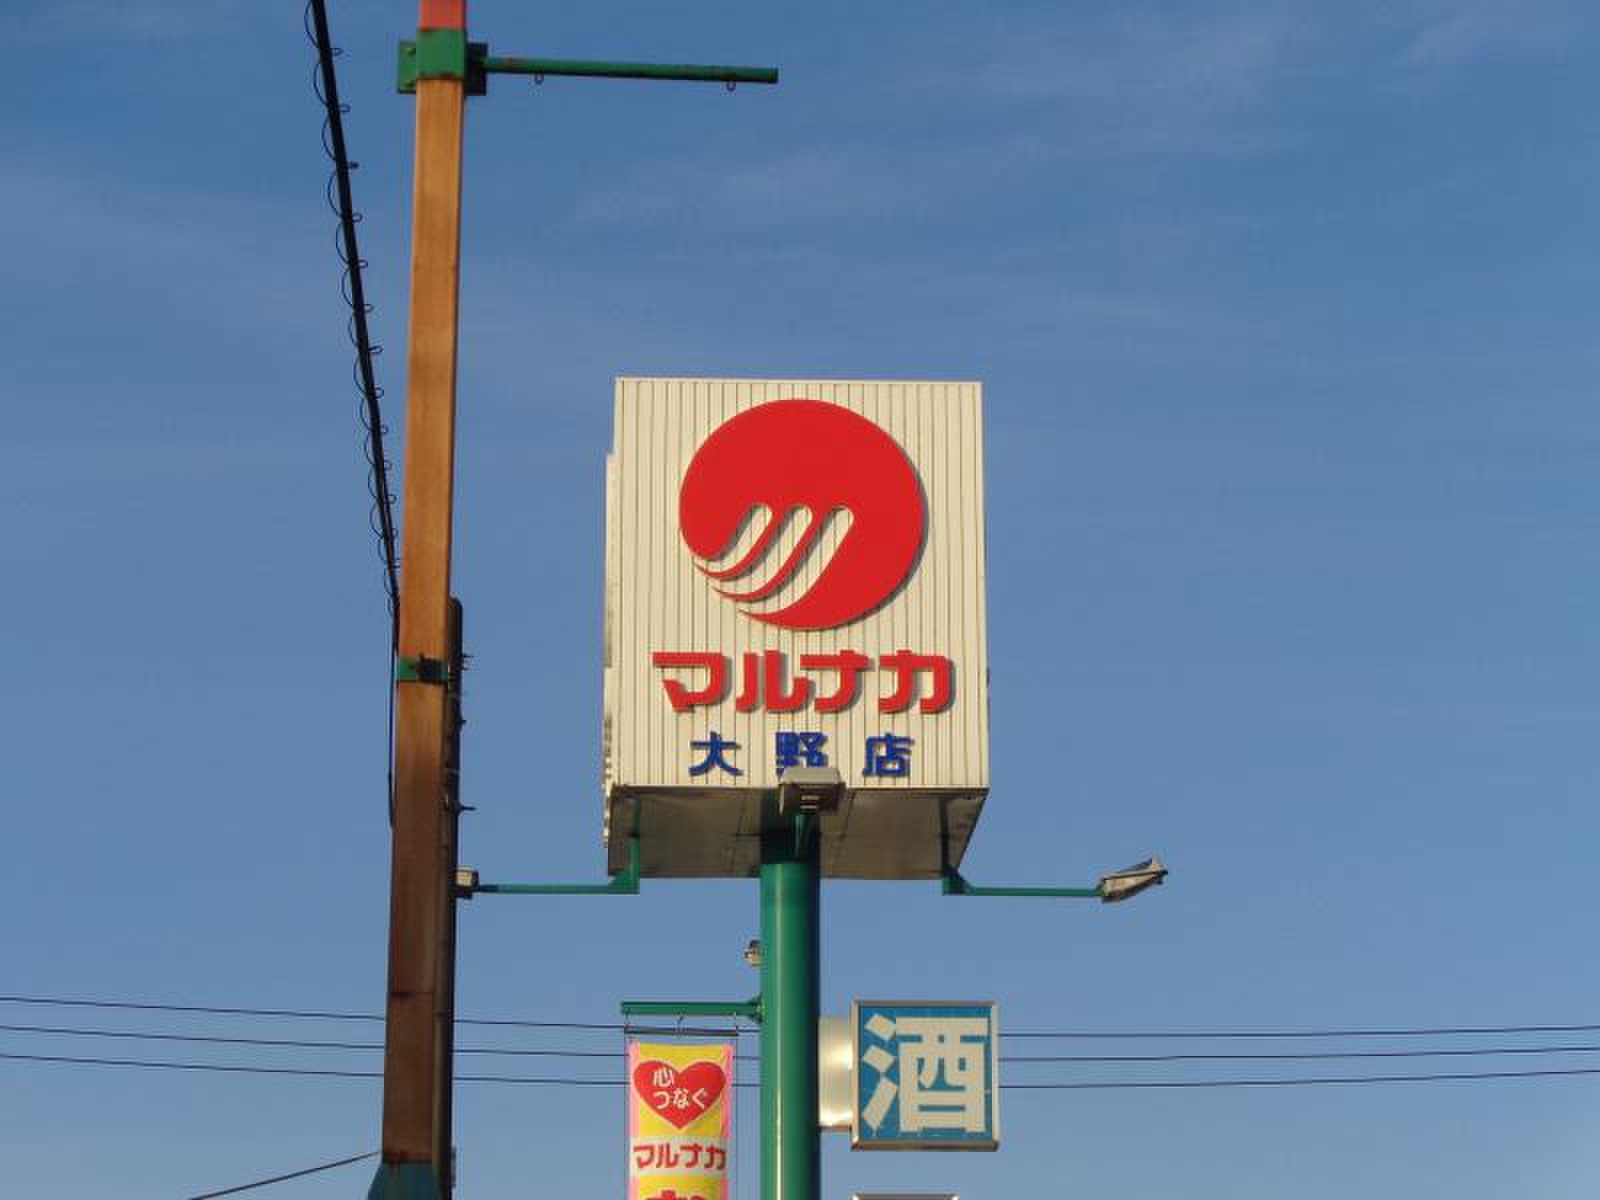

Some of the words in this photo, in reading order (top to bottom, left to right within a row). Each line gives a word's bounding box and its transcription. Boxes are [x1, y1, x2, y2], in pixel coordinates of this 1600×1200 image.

[652, 650, 952, 714] マルナカ
[689, 731, 914, 776] 大野店
[653, 1069, 674, 1088] 心
[862, 1013, 989, 1136] 酒
[652, 1087, 707, 1110] つなぐ
[633, 1142, 726, 1170] マルナカ
